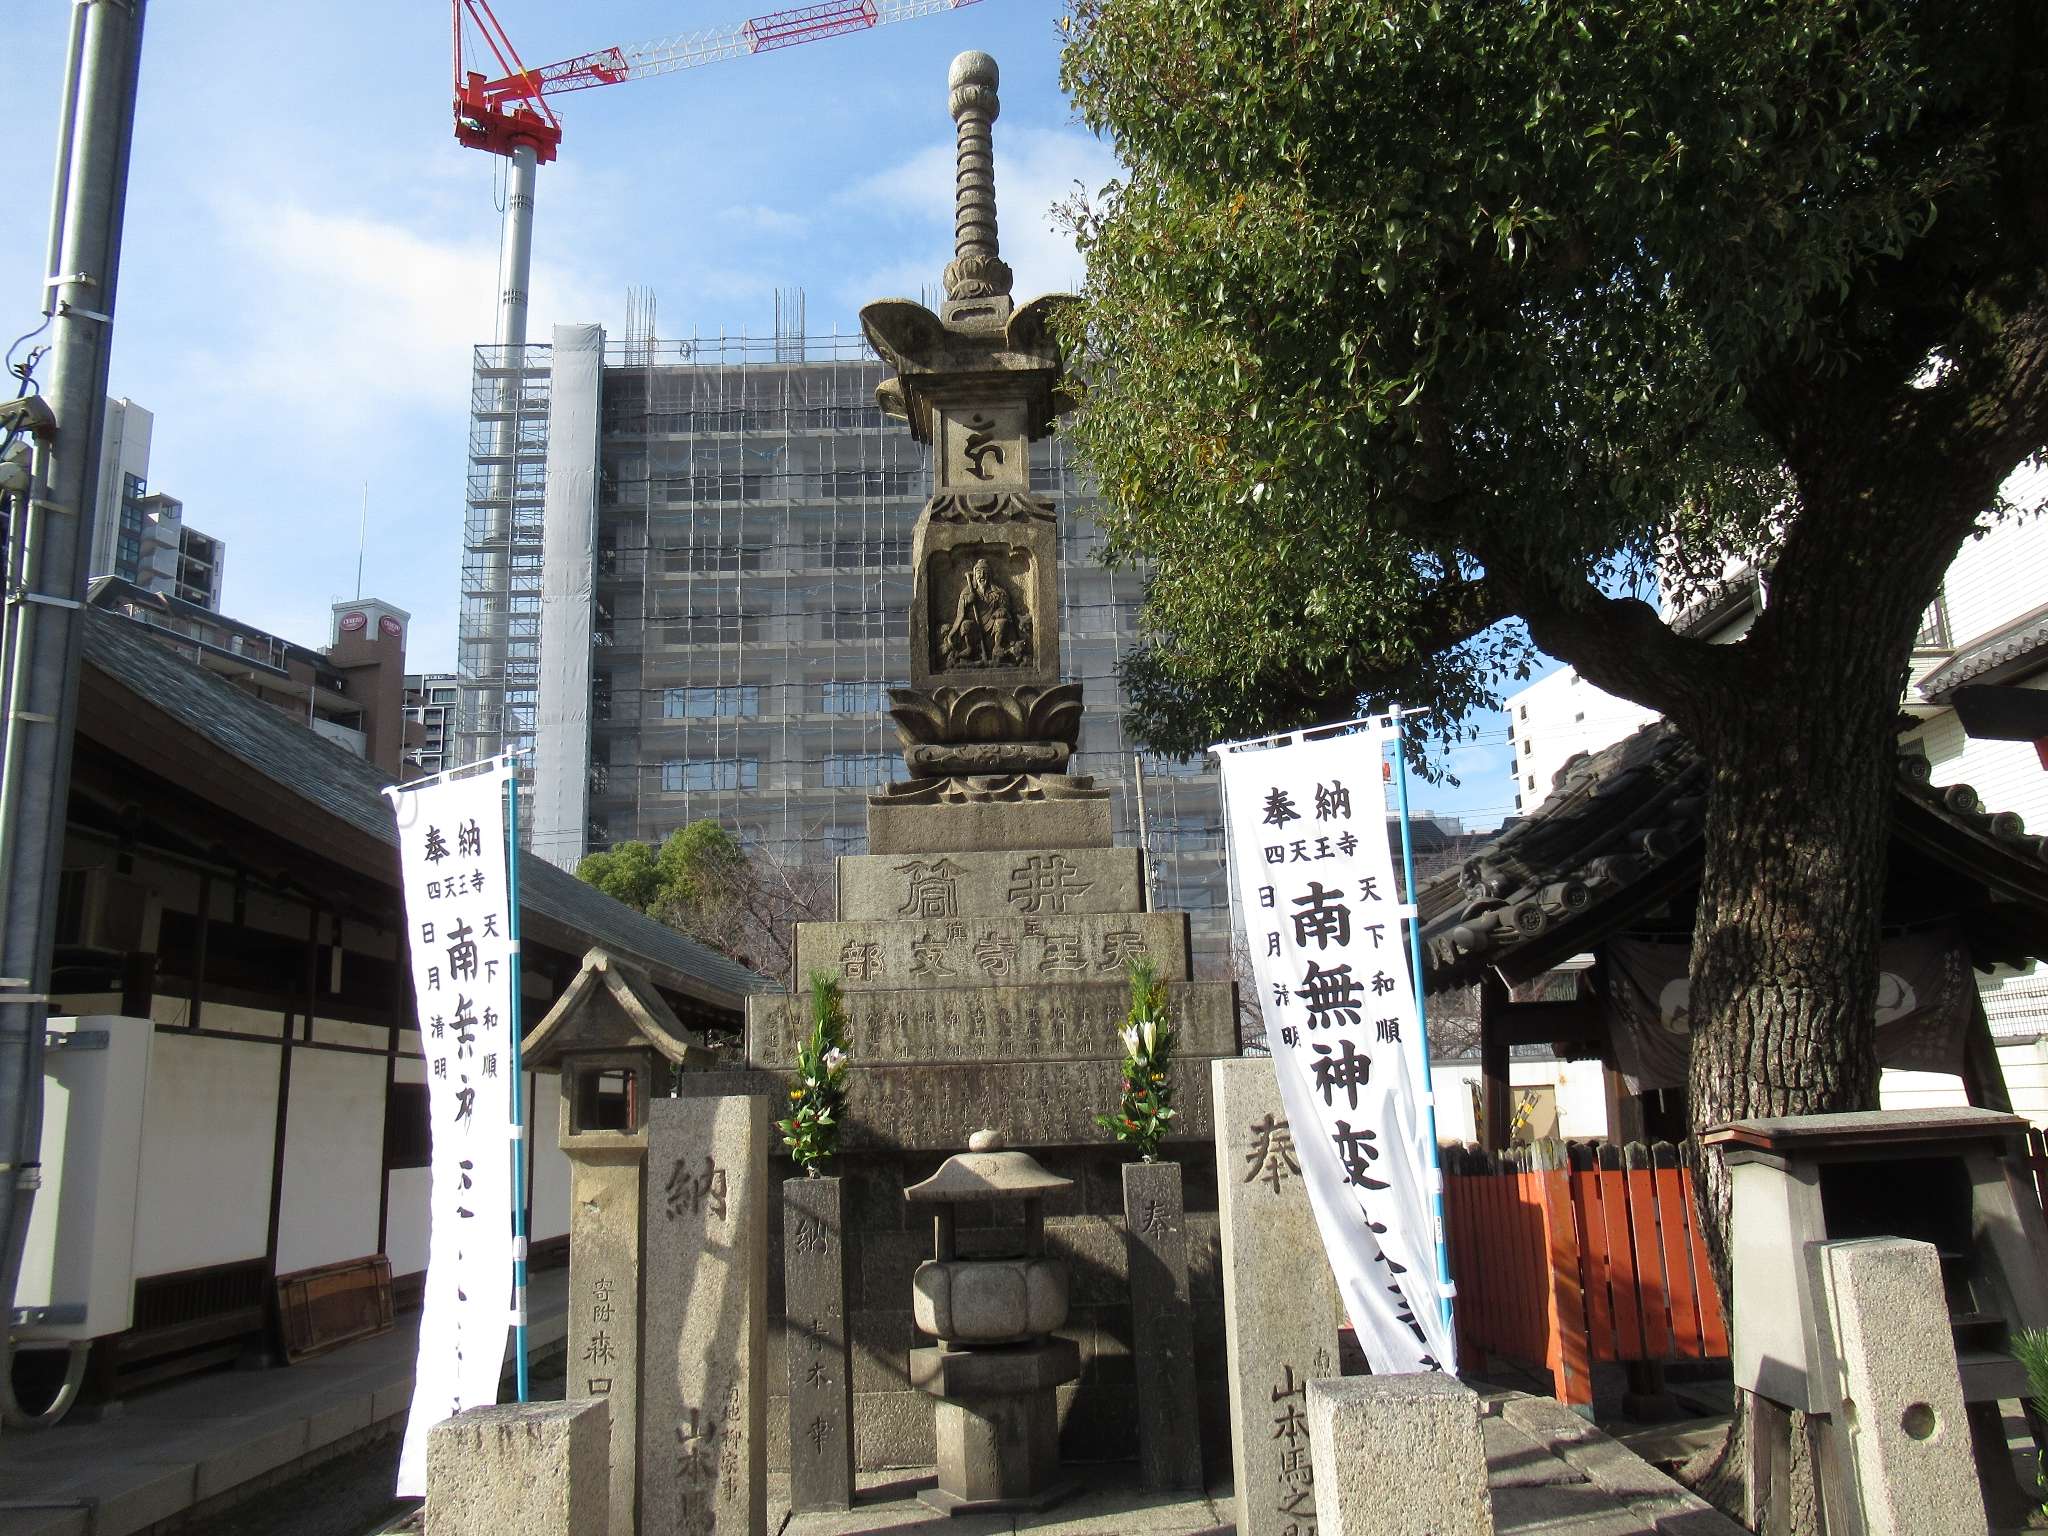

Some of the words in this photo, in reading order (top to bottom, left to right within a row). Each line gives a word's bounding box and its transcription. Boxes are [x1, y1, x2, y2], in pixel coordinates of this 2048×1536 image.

[424, 818, 482, 866] 奉納
[1262, 780, 1352, 830] 奉納
[426, 869, 486, 900] 四天王寺
[1264, 831, 1359, 864] 四天王寺
[481, 913, 500, 1079] 天下和順
[1258, 885, 1302, 1048] 日月清明
[1359, 876, 1402, 1045] 天下和順
[421, 921, 448, 1081] 日月清明
[664, 1155, 728, 1223] 納
[1244, 1113, 1303, 1195] 奉
